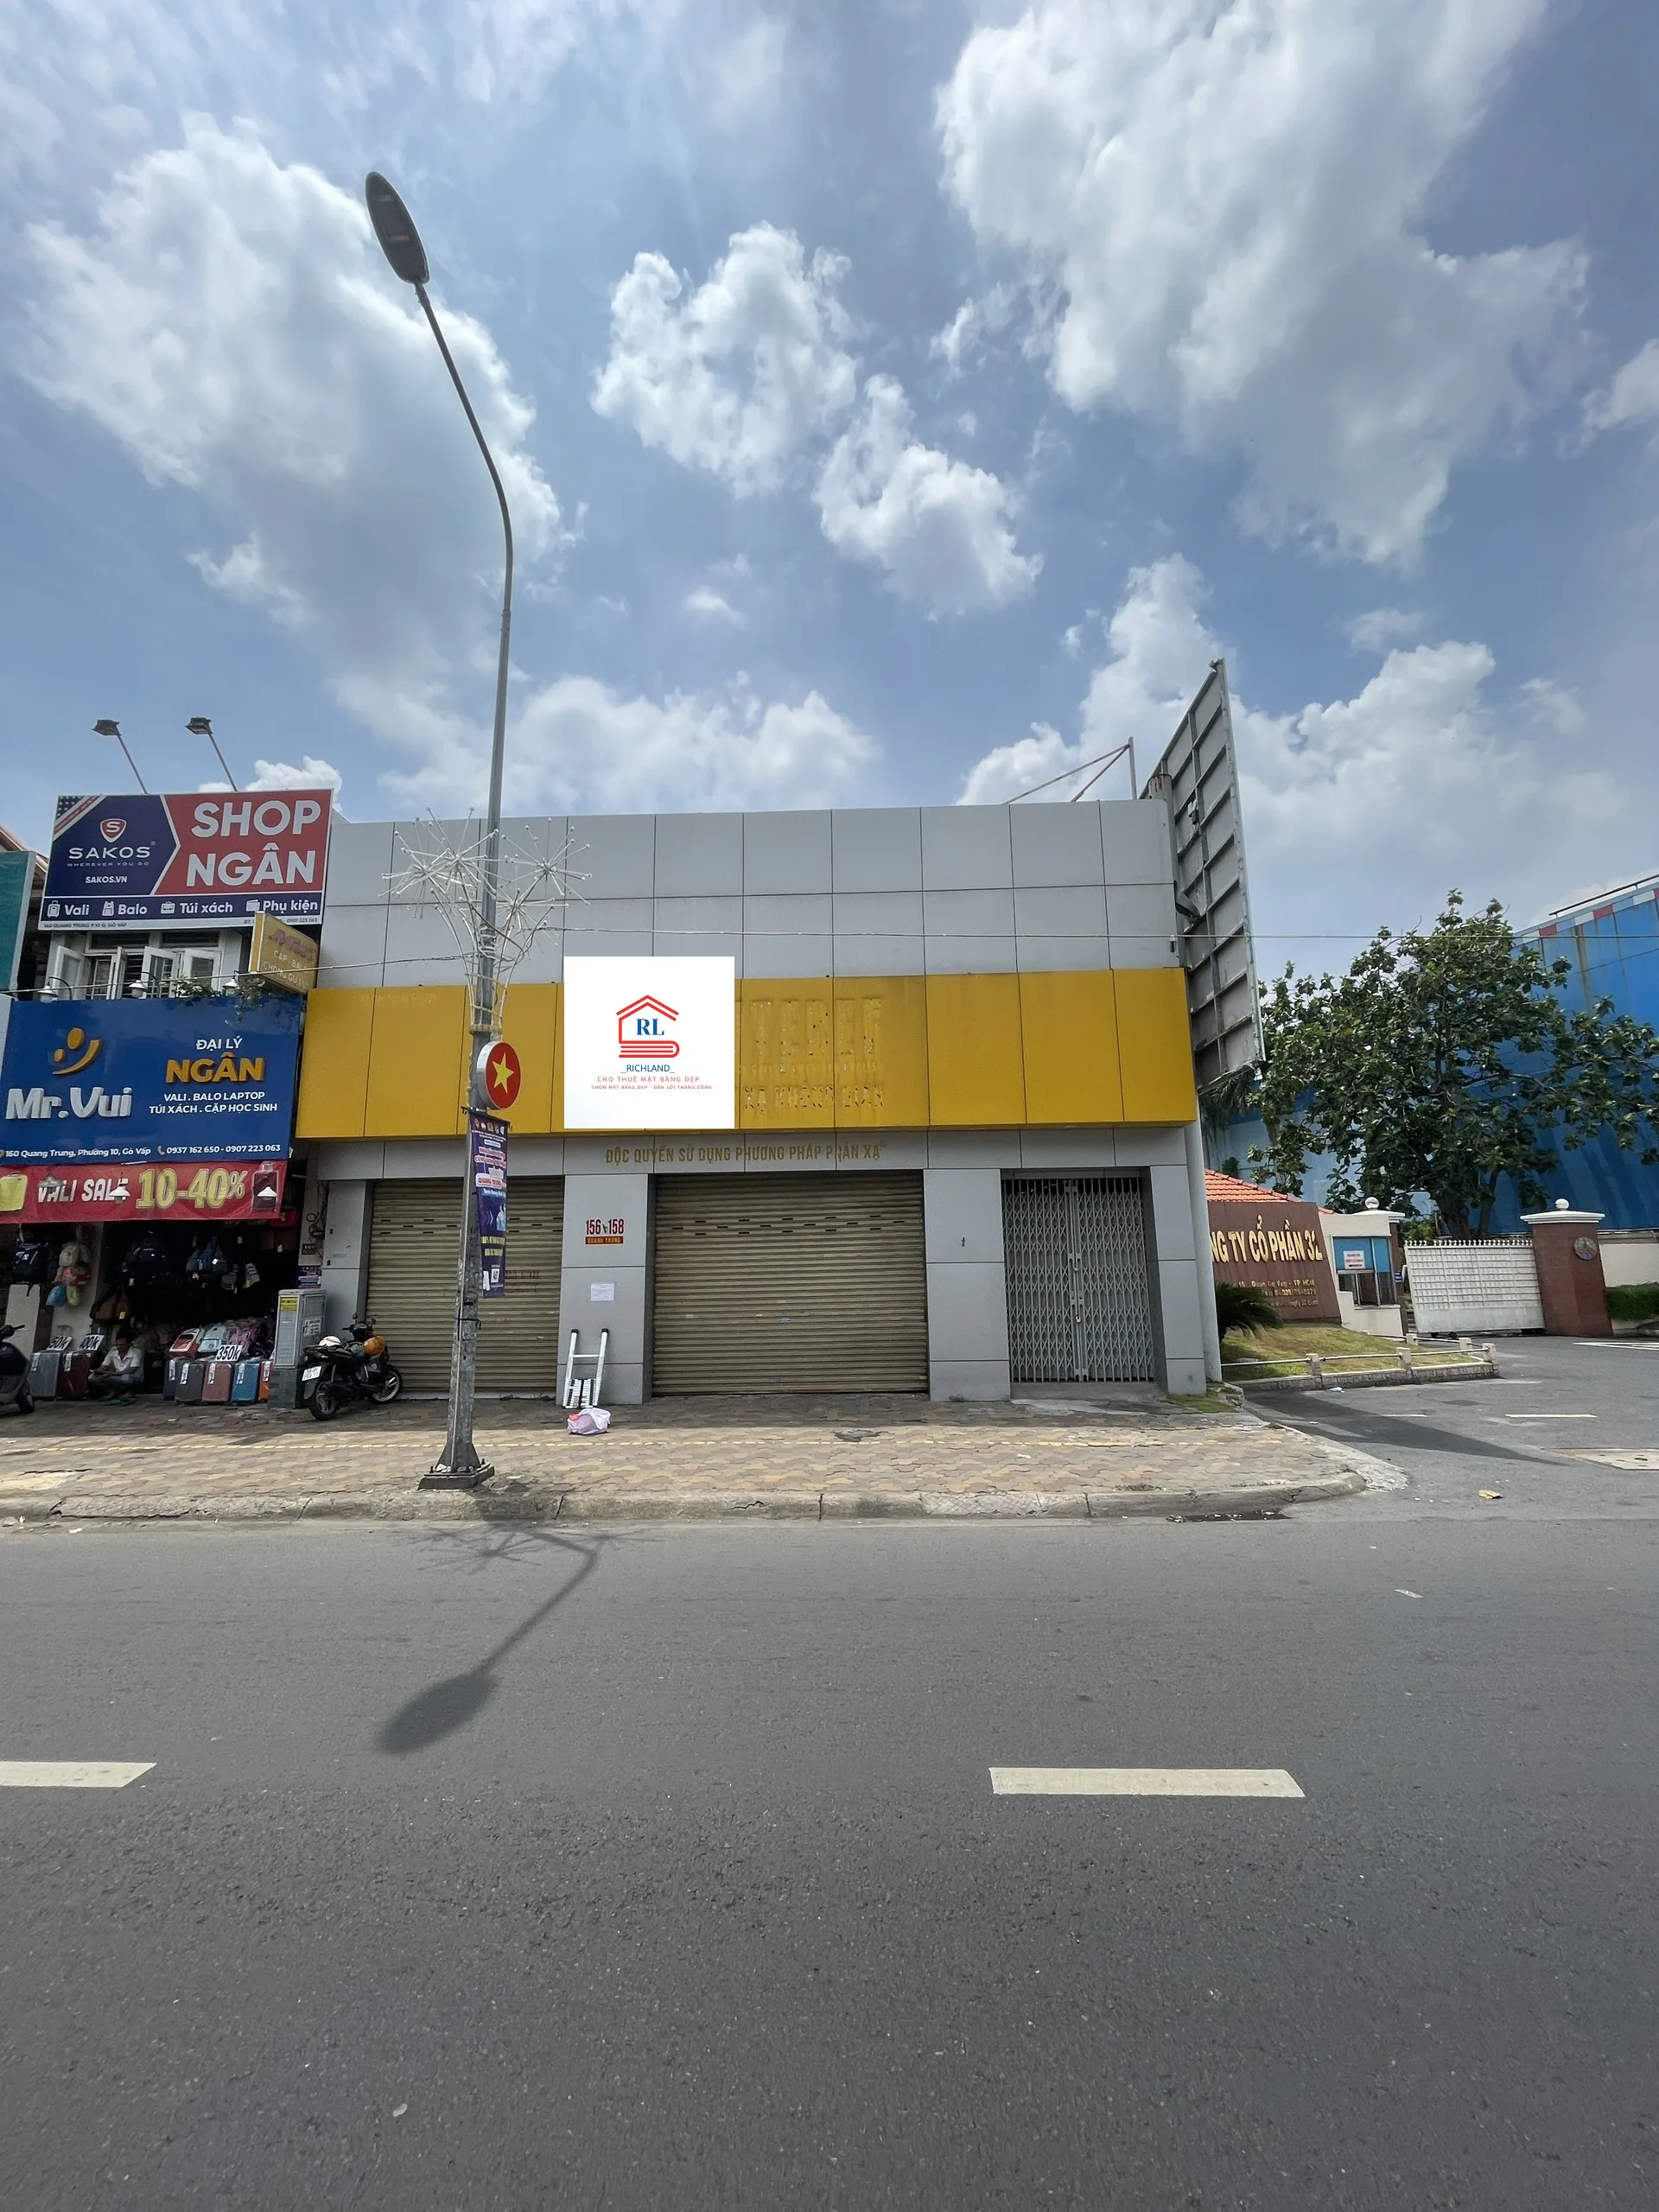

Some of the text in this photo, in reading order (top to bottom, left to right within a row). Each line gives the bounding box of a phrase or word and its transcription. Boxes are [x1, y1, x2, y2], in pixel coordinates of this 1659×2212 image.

[191, 799, 321, 838] SHOP
[68, 846, 150, 860] SAKOS
[186, 842, 316, 887] NGÂN
[85, 875, 128, 884] SAKOS.VN
[64, 899, 318, 916] Vali Balo Túi xách Phụ kiện
[195, 1035, 243, 1052] ĐẠI LÝ
[165, 1051, 265, 1084] NGÂN
[5, 1086, 133, 1120] Mr.Vui
[163, 1091, 265, 1102] VALI BALO LAPTOP
[149, 1103, 277, 1116] TÚI XÁCH CẶP HỌC SINH
[20, 1150, 48, 1159] Quang
[77, 1147, 109, 1157] Phường
[136, 1147, 151, 1156] Vấp
[167, 1146, 188, 1154] 0937
[605, 1146, 630, 1166] ĐỘC
[698, 1147, 731, 1164] DỤNG
[735, 1145, 785, 1161] PHƯƠNG
[789, 1142, 821, 1160] PHÁP
[136, 1167, 248, 1209] 10-40%
[586, 1218, 625, 1236] 156 158
[1228, 1230, 1247, 1262] TY
[1248, 1214, 1269, 1262] CỔ
[1268, 1218, 1306, 1262] PHẦN
[216, 1345, 242, 1361] 350k
